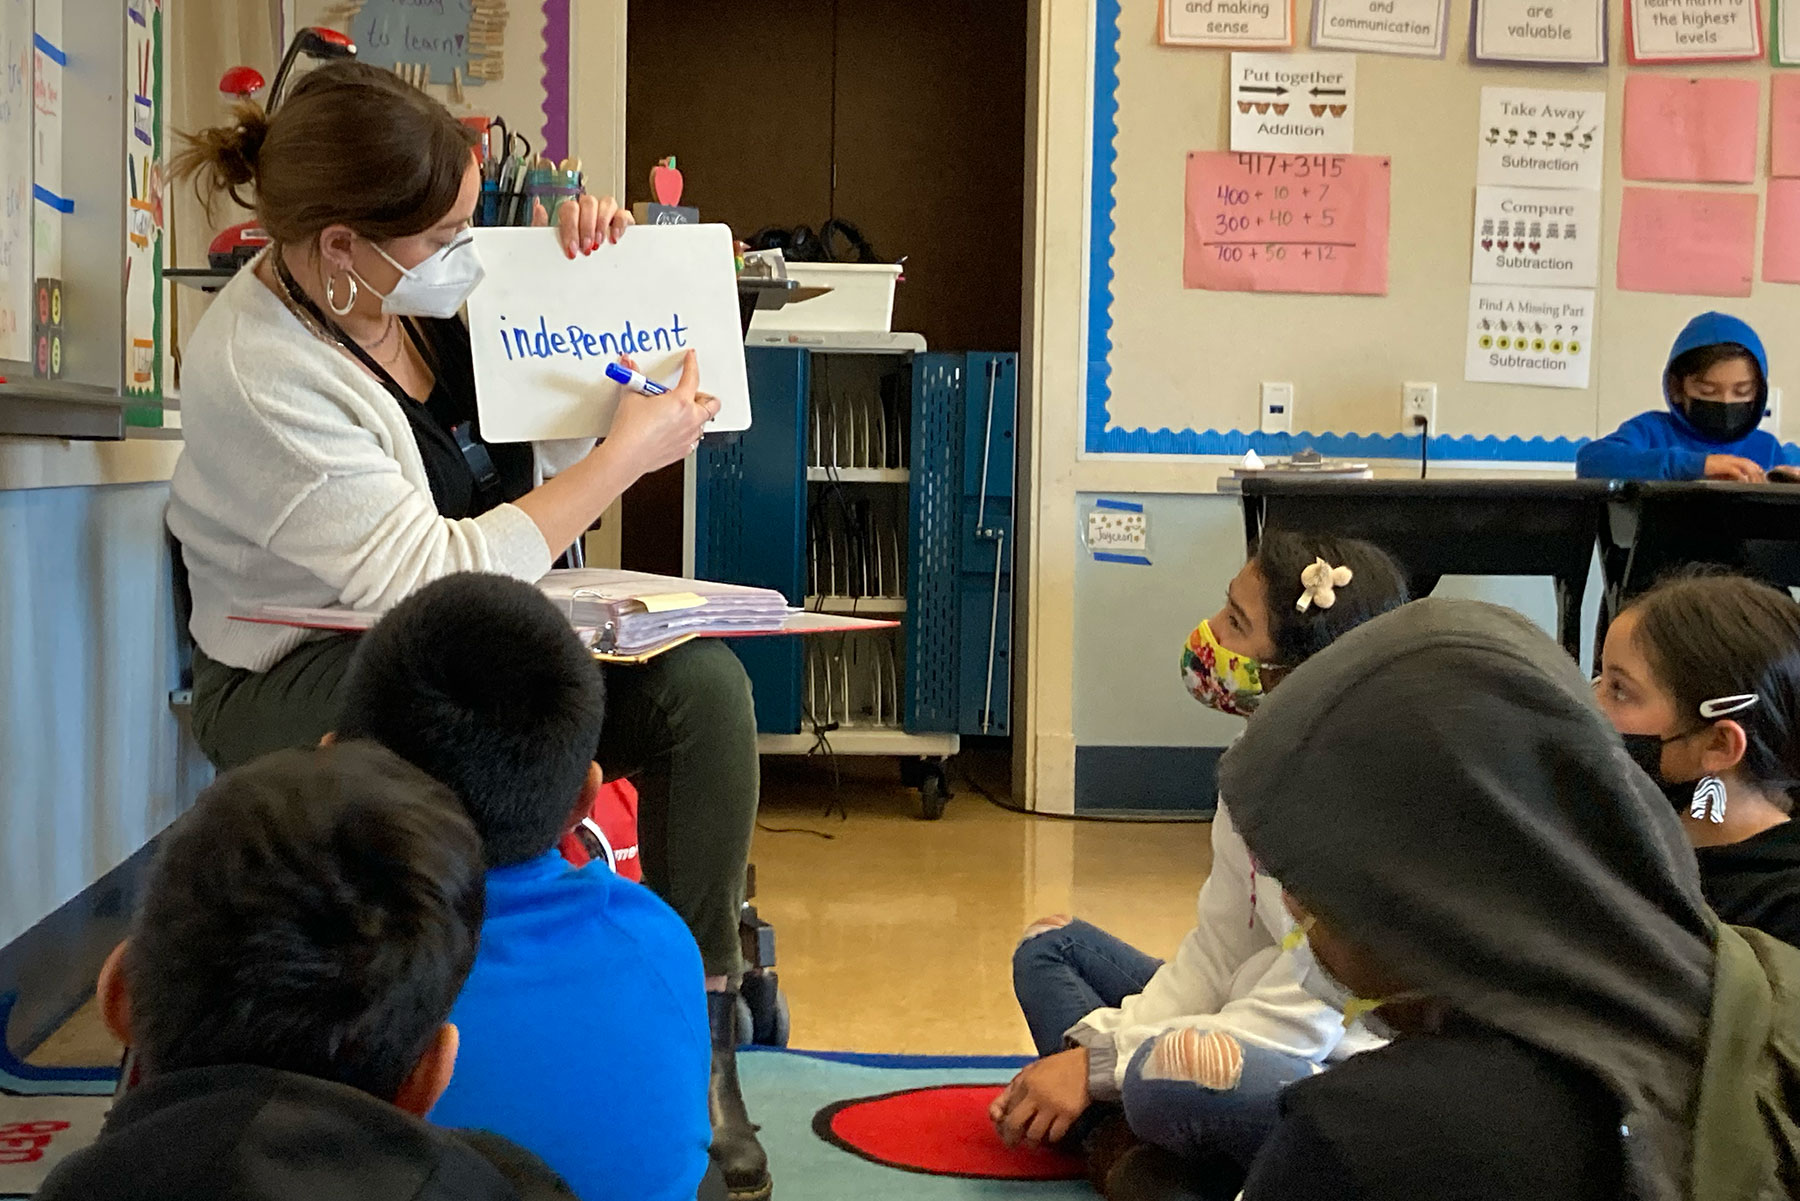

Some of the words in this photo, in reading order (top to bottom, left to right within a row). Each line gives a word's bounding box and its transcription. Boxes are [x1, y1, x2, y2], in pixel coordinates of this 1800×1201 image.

[1185, 0, 1212, 13] and
[1217, 0, 1270, 18] making
[1369, 0, 1394, 14] and
[1526, 6, 1553, 18] are
[1206, 21, 1249, 34] sense
[1330, 15, 1431, 35] communication
[1652, 12, 1677, 26] the
[1682, 11, 1737, 28] highest
[367, 17, 390, 49] to
[1507, 23, 1572, 40] valuable
[1675, 31, 1718, 44] levels
[1243, 68, 1270, 82] Put
[1274, 70, 1344, 86] together
[1500, 101, 1537, 117] Take
[1541, 103, 1585, 123] Away
[1257, 122, 1325, 137] Addition
[1501, 155, 1579, 171] Subtraction
[1217, 185, 1250, 206] 400
[1500, 200, 1575, 217] Compare
[1215, 213, 1250, 235] 300
[1496, 254, 1574, 271] Subtraction
[1478, 298, 1503, 311] Find
[1505, 299, 1515, 312] A
[1519, 300, 1560, 318] Missing
[1562, 303, 1585, 318] Part
[1489, 353, 1567, 371] Subtraction
